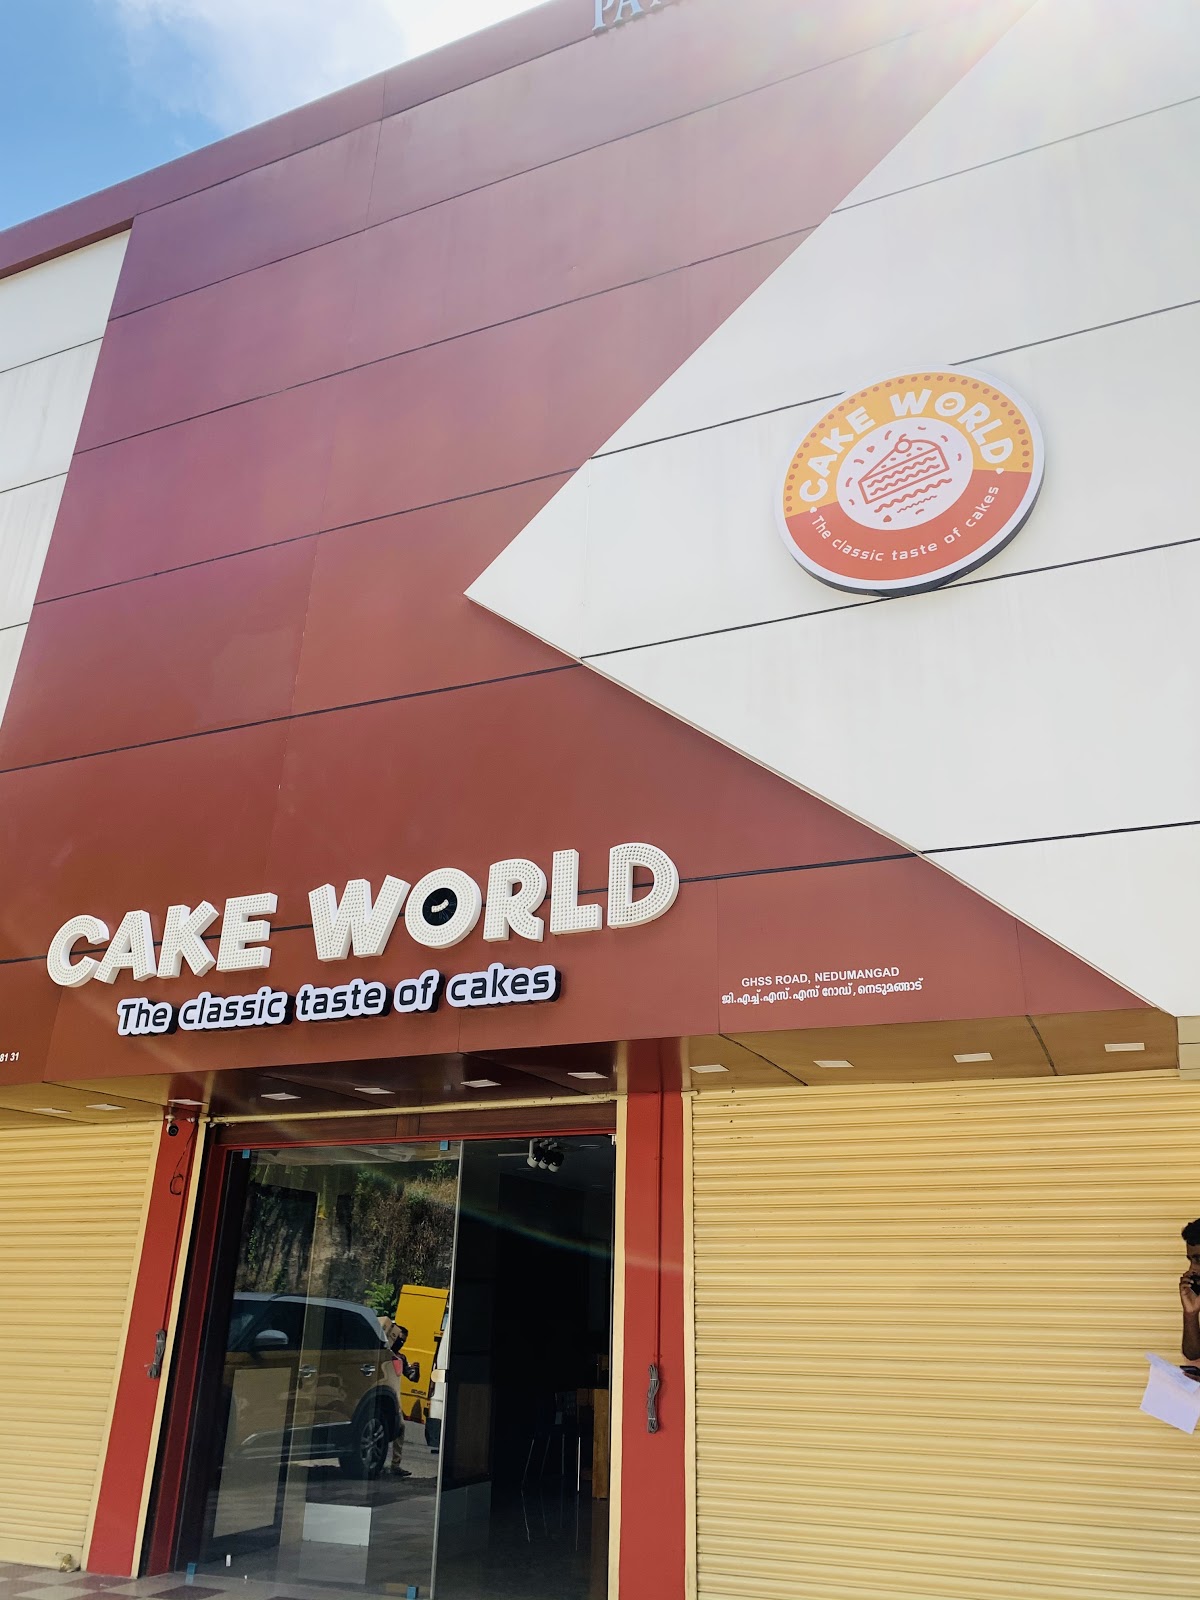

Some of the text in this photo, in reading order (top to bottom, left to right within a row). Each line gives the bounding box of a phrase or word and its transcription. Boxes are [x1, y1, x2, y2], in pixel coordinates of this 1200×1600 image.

[799, 388, 1014, 503] CAKE WORLD
[811, 486, 999, 562] The classic taste of cakes
[46, 842, 680, 988] CAKE WORLD
[119, 967, 551, 1031] The classic taste of cakes
[741, 966, 900, 987] GHSS ROAD, NEDUMANGAD
